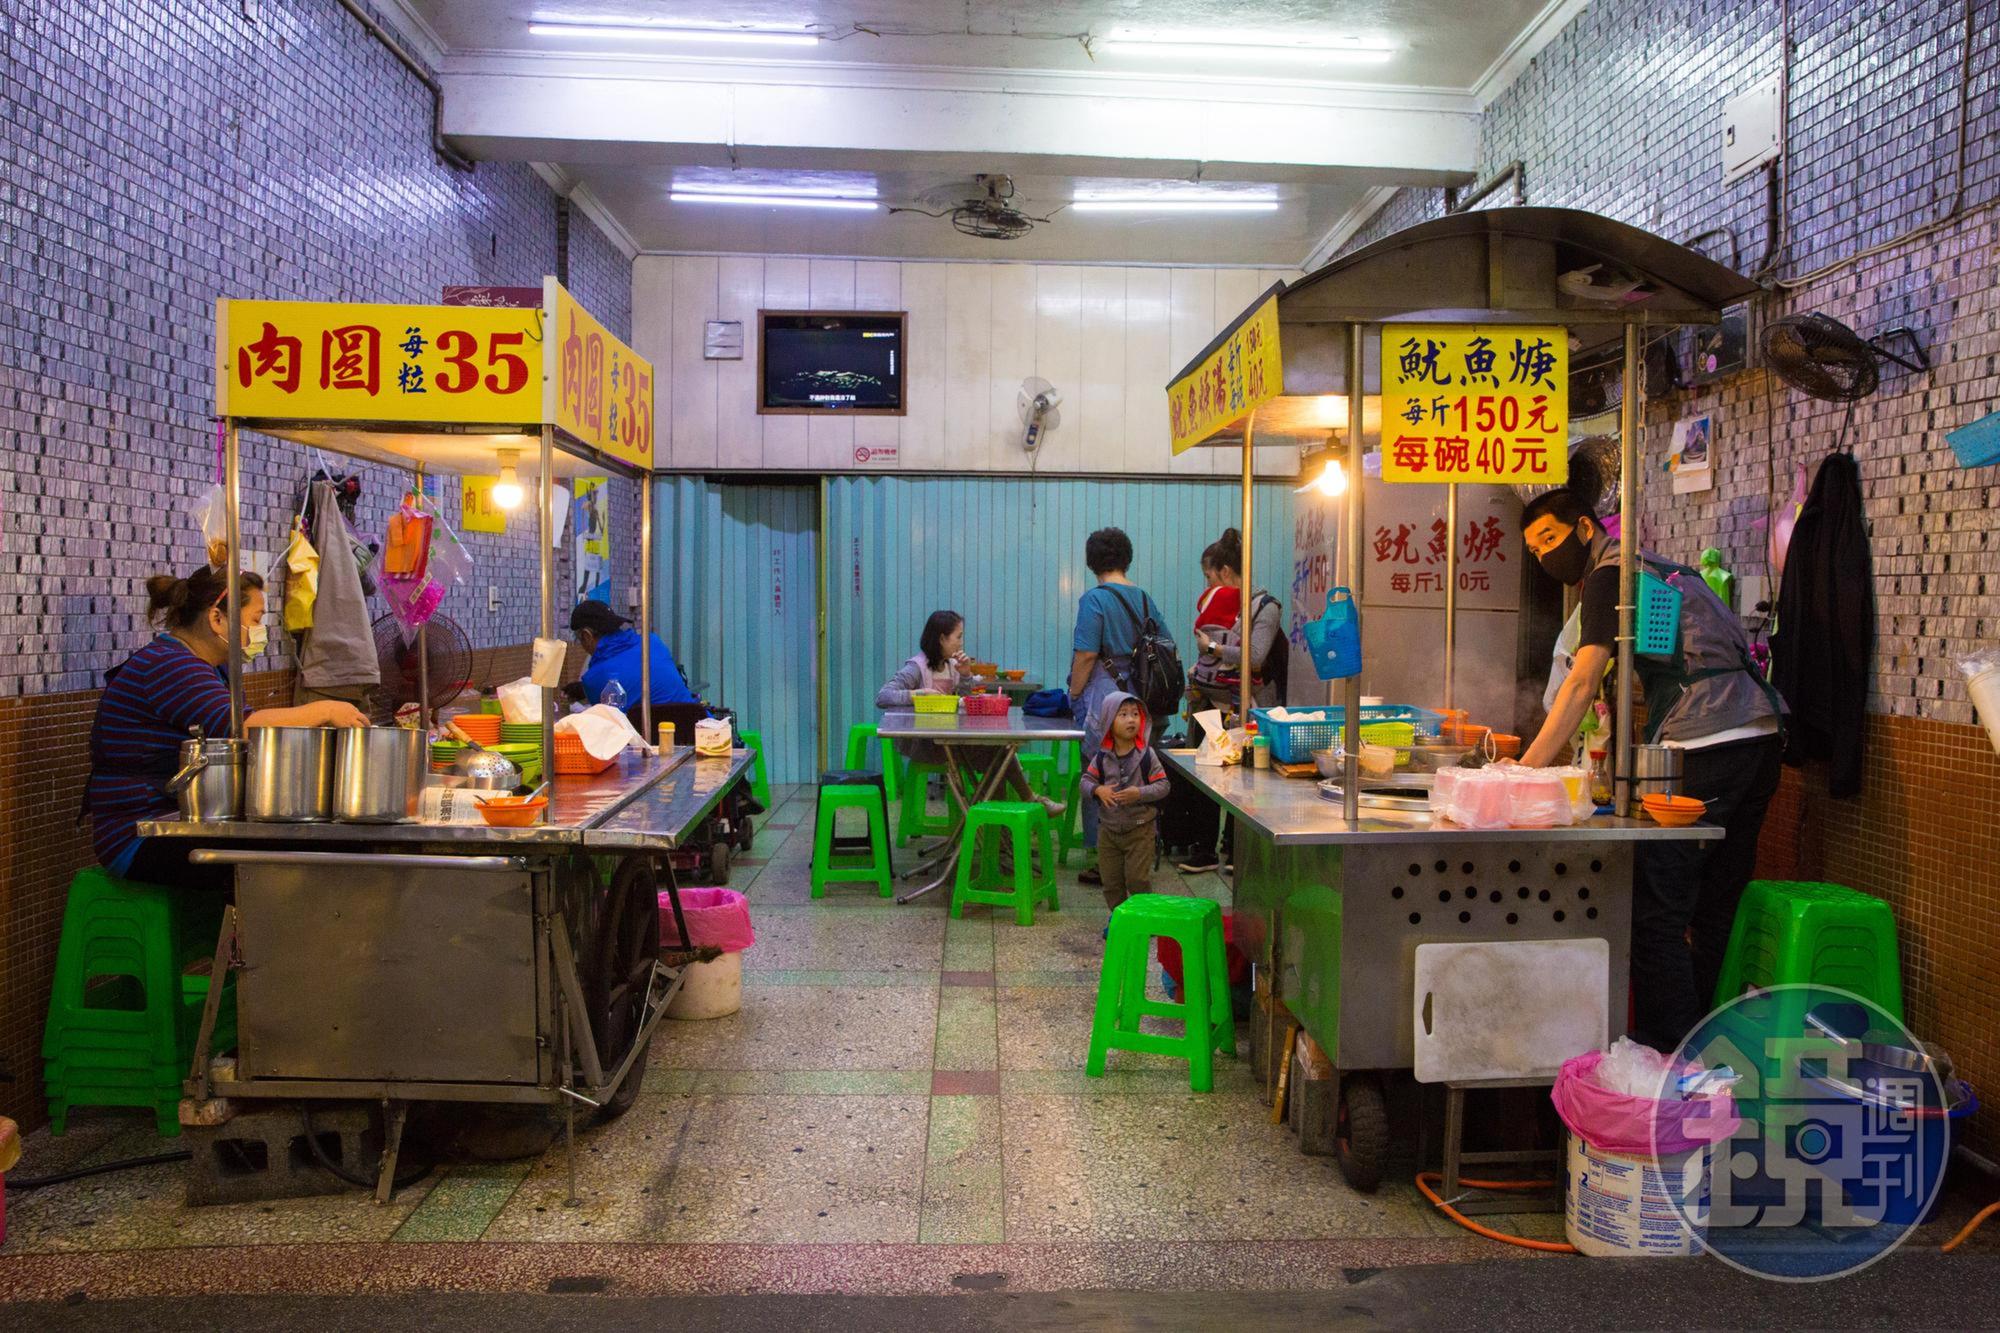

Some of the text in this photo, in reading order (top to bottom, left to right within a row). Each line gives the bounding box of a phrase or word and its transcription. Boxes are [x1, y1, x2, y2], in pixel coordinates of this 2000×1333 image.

[238, 322, 529, 397] 肉圓 每粒 35
[562, 307, 605, 441] 肉圓
[622, 361, 650, 454] 35
[1393, 435, 1548, 474] 每碗40元
[1391, 571, 1491, 593] 每斤10元
